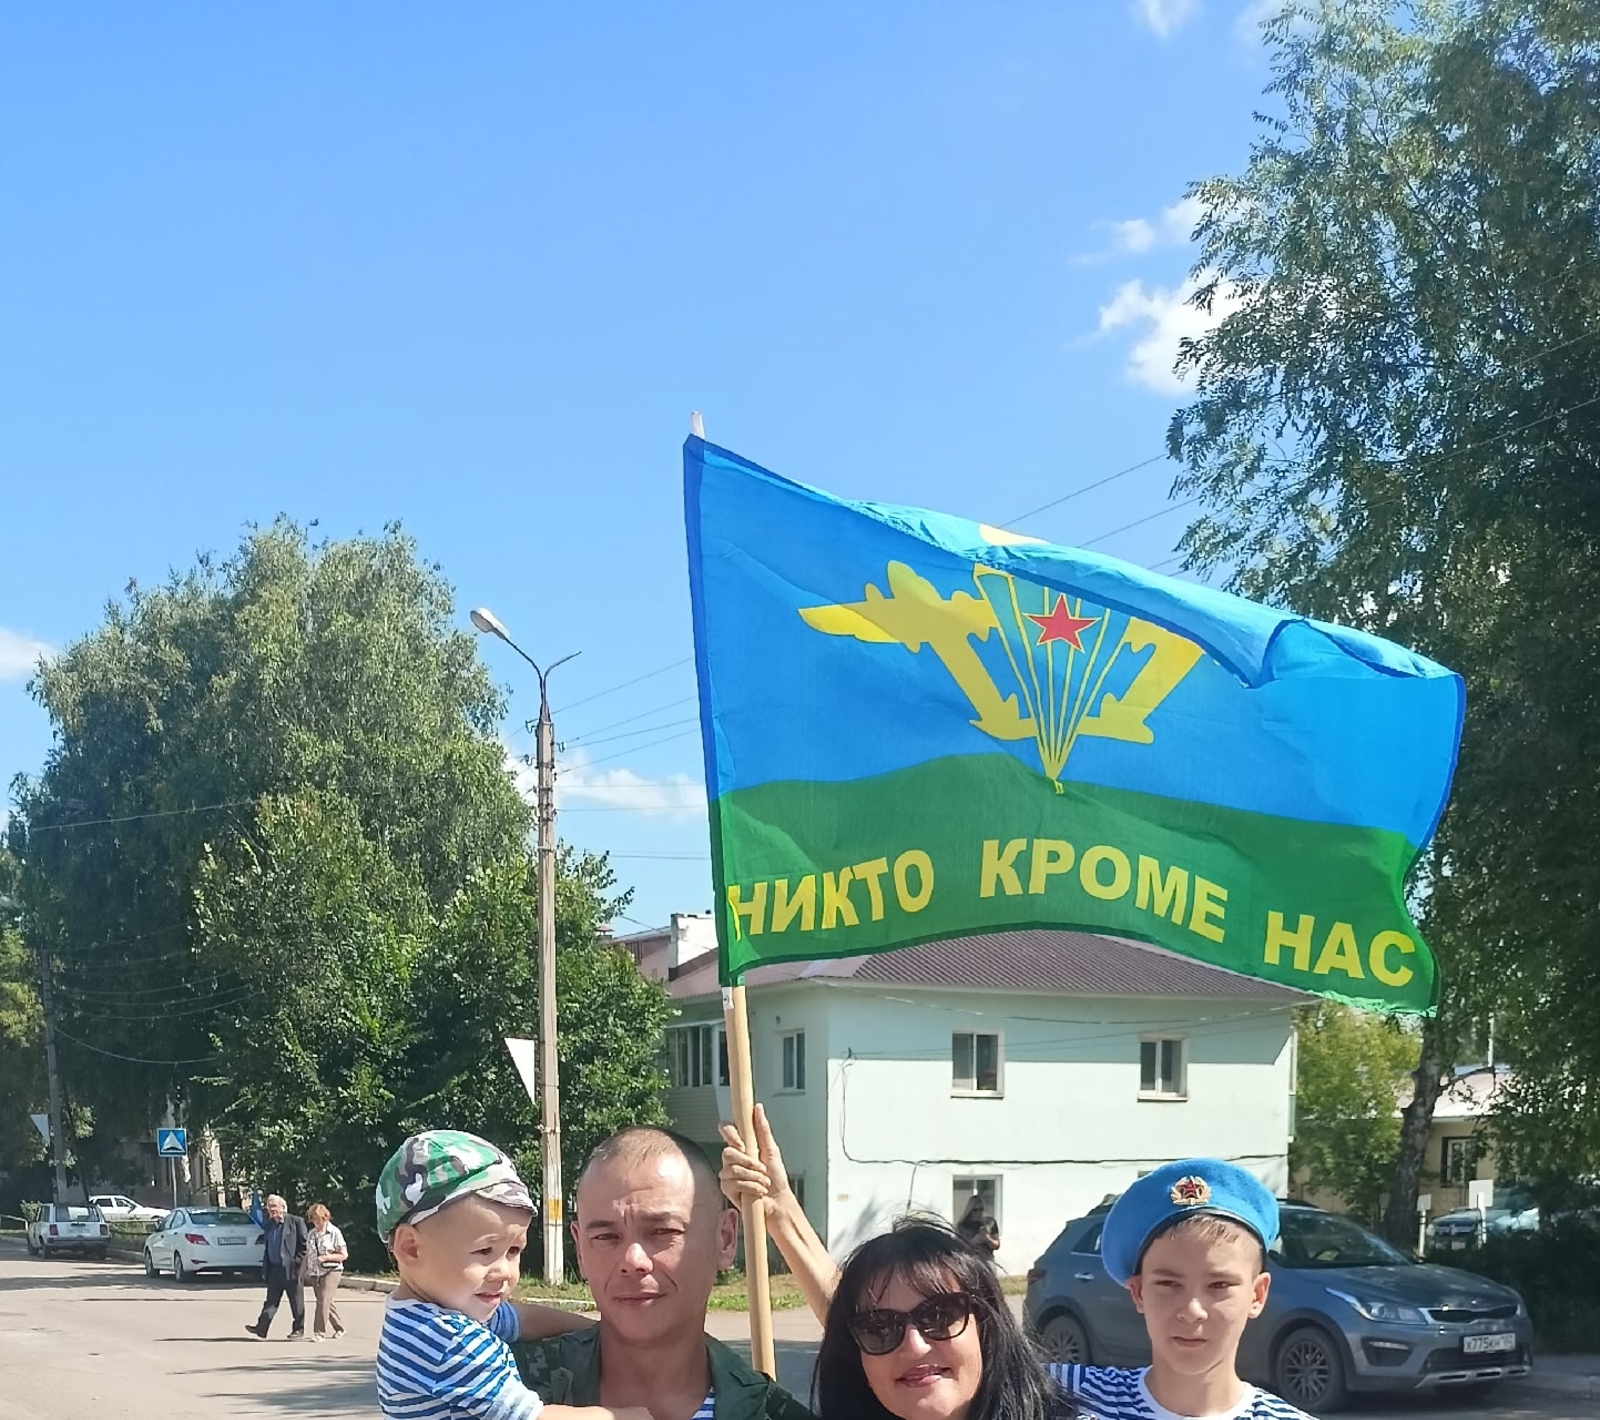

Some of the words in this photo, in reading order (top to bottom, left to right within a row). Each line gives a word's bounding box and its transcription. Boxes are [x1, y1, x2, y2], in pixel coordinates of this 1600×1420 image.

[728, 850, 934, 941] НИКТО
[979, 838, 1228, 943] КРОМЕ
[1263, 911, 1415, 987] НАС
